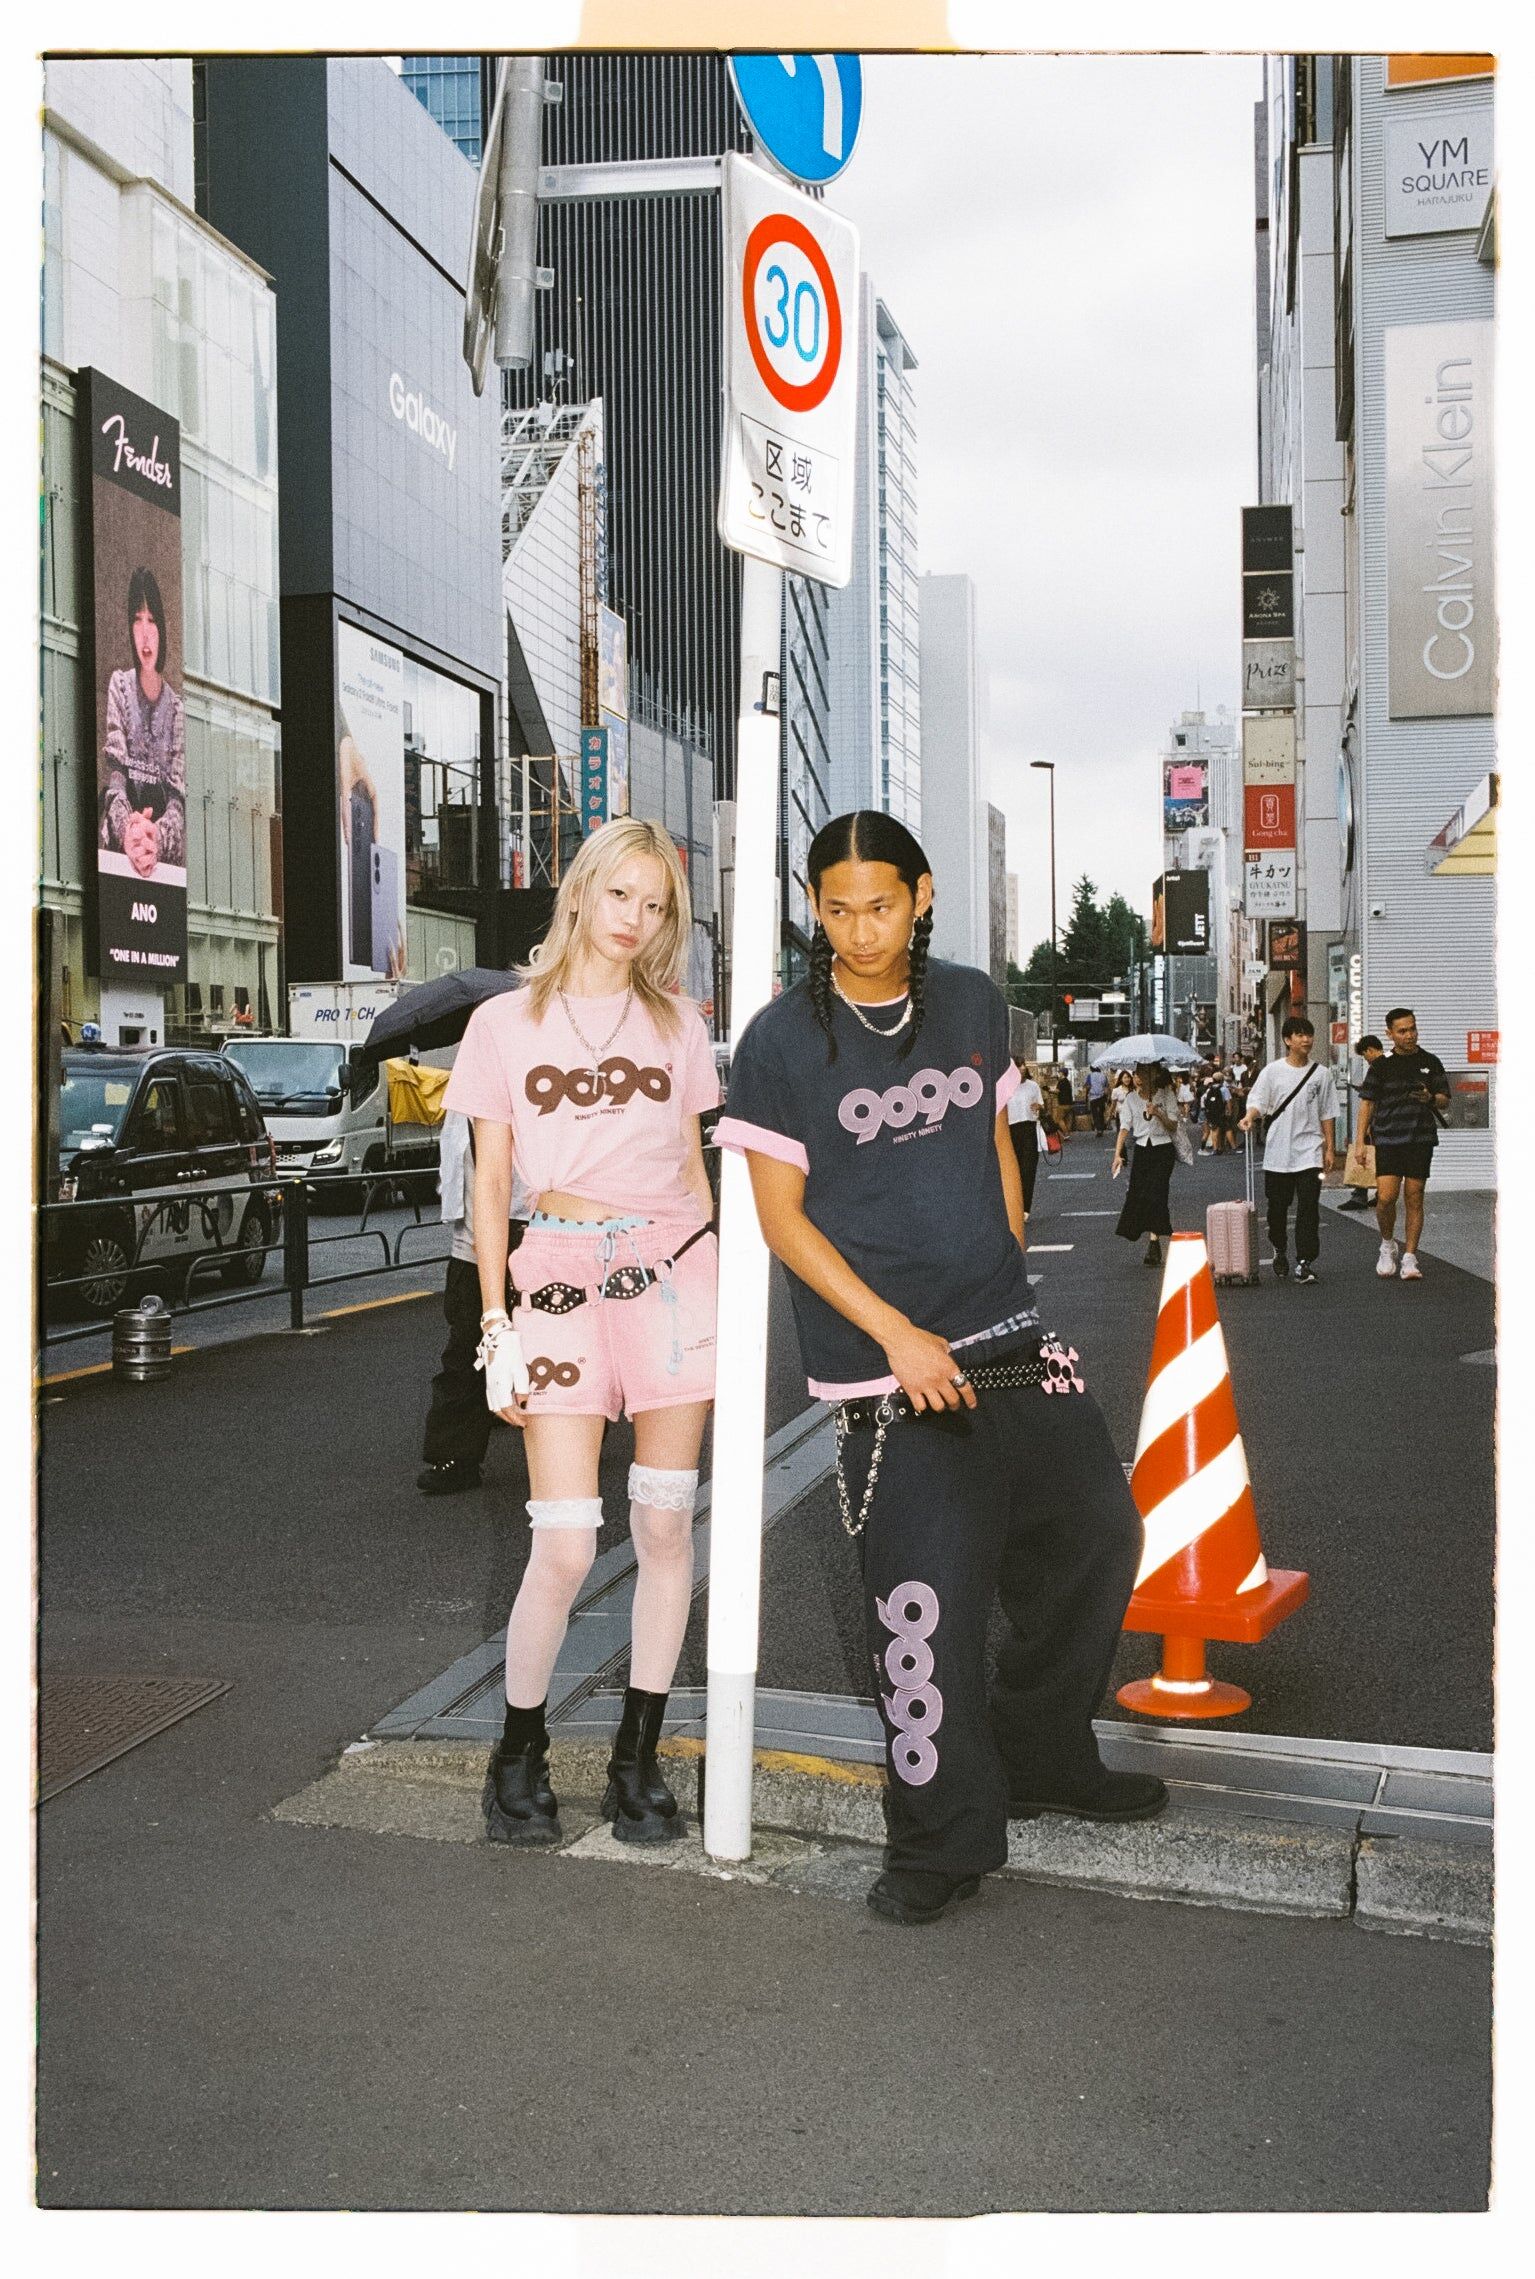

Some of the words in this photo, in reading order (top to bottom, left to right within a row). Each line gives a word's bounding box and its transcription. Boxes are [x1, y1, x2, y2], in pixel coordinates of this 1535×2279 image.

[1417, 137, 1468, 169] YM
[1401, 169, 1489, 194] SQUARE
[1417, 193, 1473, 206] HARAJUKU
[764, 264, 820, 363] 30
[389, 372, 457, 471] Galaxy
[1421, 356, 1474, 490] Klein
[101, 414, 173, 489] Fender
[766, 439, 813, 495] 区域
[748, 481, 831, 550] ここまで
[1421, 505, 1475, 680] Calvin
[1250, 864, 1291, 880] 牛カツ
[131, 902, 158, 923] ANO
[131, 950, 140, 964] IN
[141, 951, 147, 965] A
[314, 1008, 340, 1022] PRO
[525, 1056, 671, 1117] 9090
[574, 1112, 598, 1121] NINETY
[600, 1108, 626, 1116] NINETY
[838, 1066, 983, 1146] 9090
[892, 1130, 918, 1144] NINETY
[918, 1124, 943, 1137] NINETY
[875, 1580, 943, 1786] 9090
